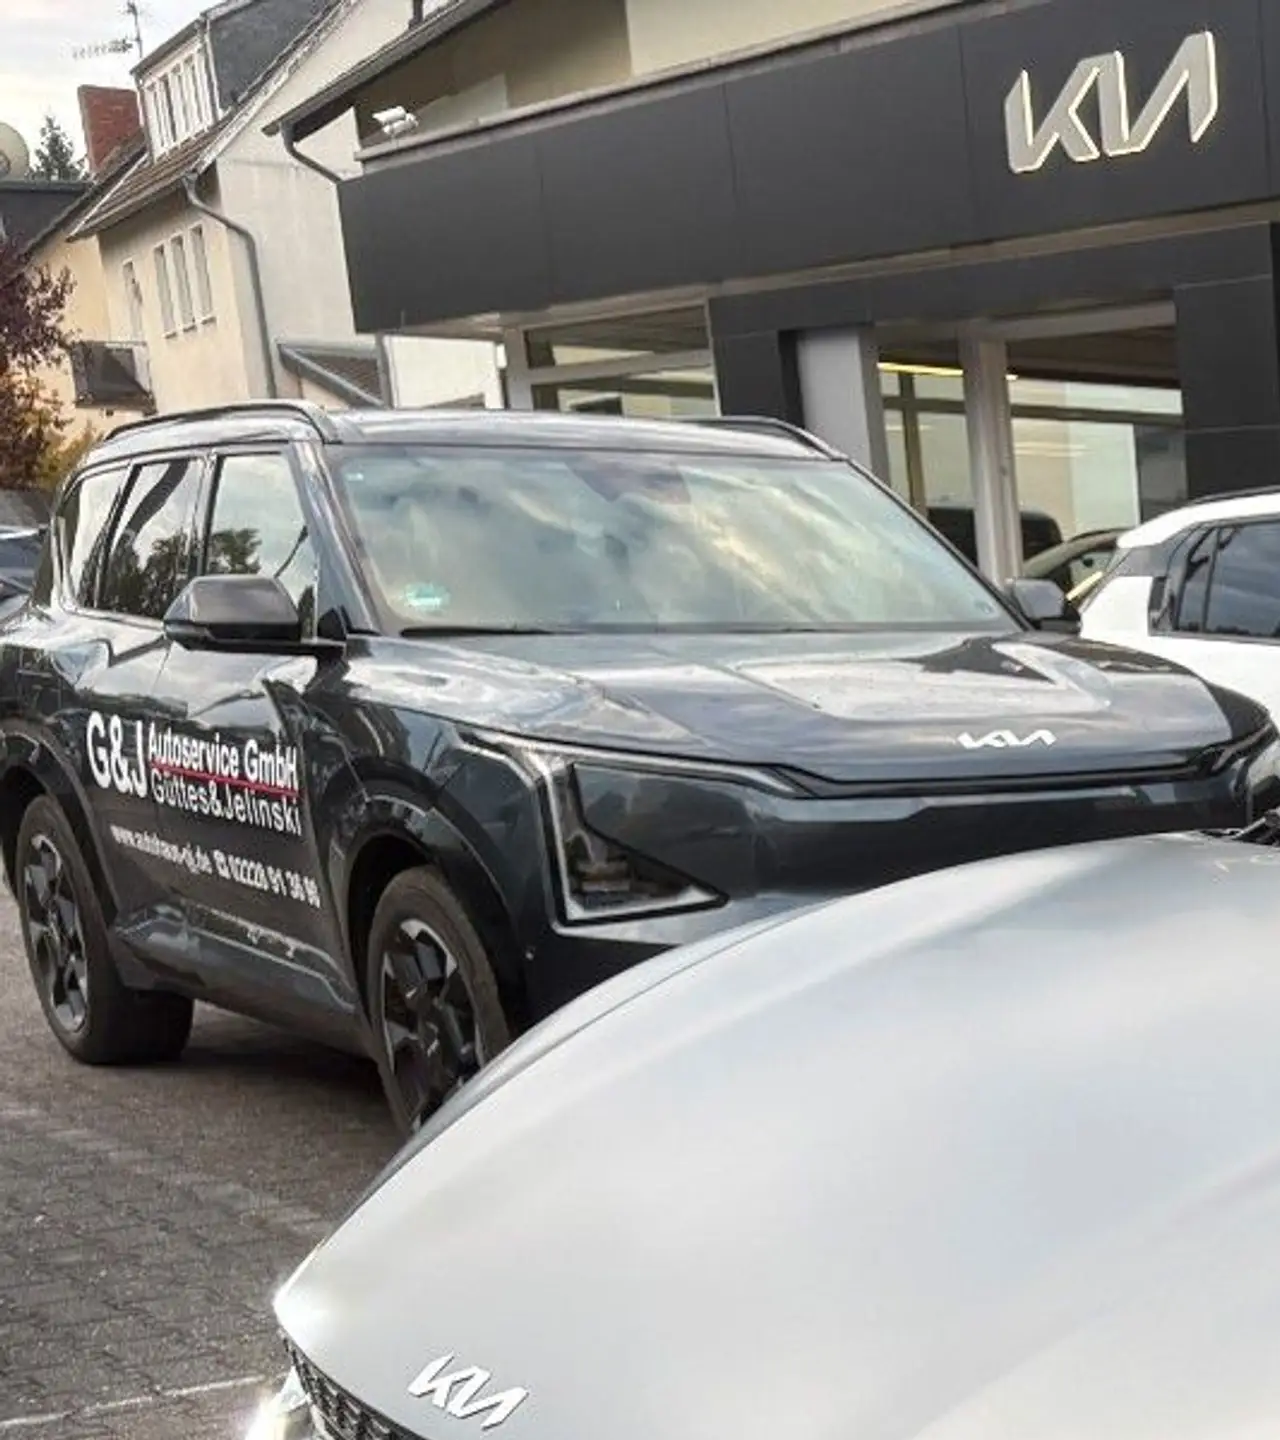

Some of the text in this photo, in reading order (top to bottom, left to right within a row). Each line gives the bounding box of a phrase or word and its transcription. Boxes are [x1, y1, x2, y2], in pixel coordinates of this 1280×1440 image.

[1004, 30, 1218, 173] KIA
[86, 710, 148, 798] G&J
[148, 721, 299, 790] Autoservice GmbH
[957, 729, 1057, 750] KIA
[407, 1350, 530, 1431] KIA
